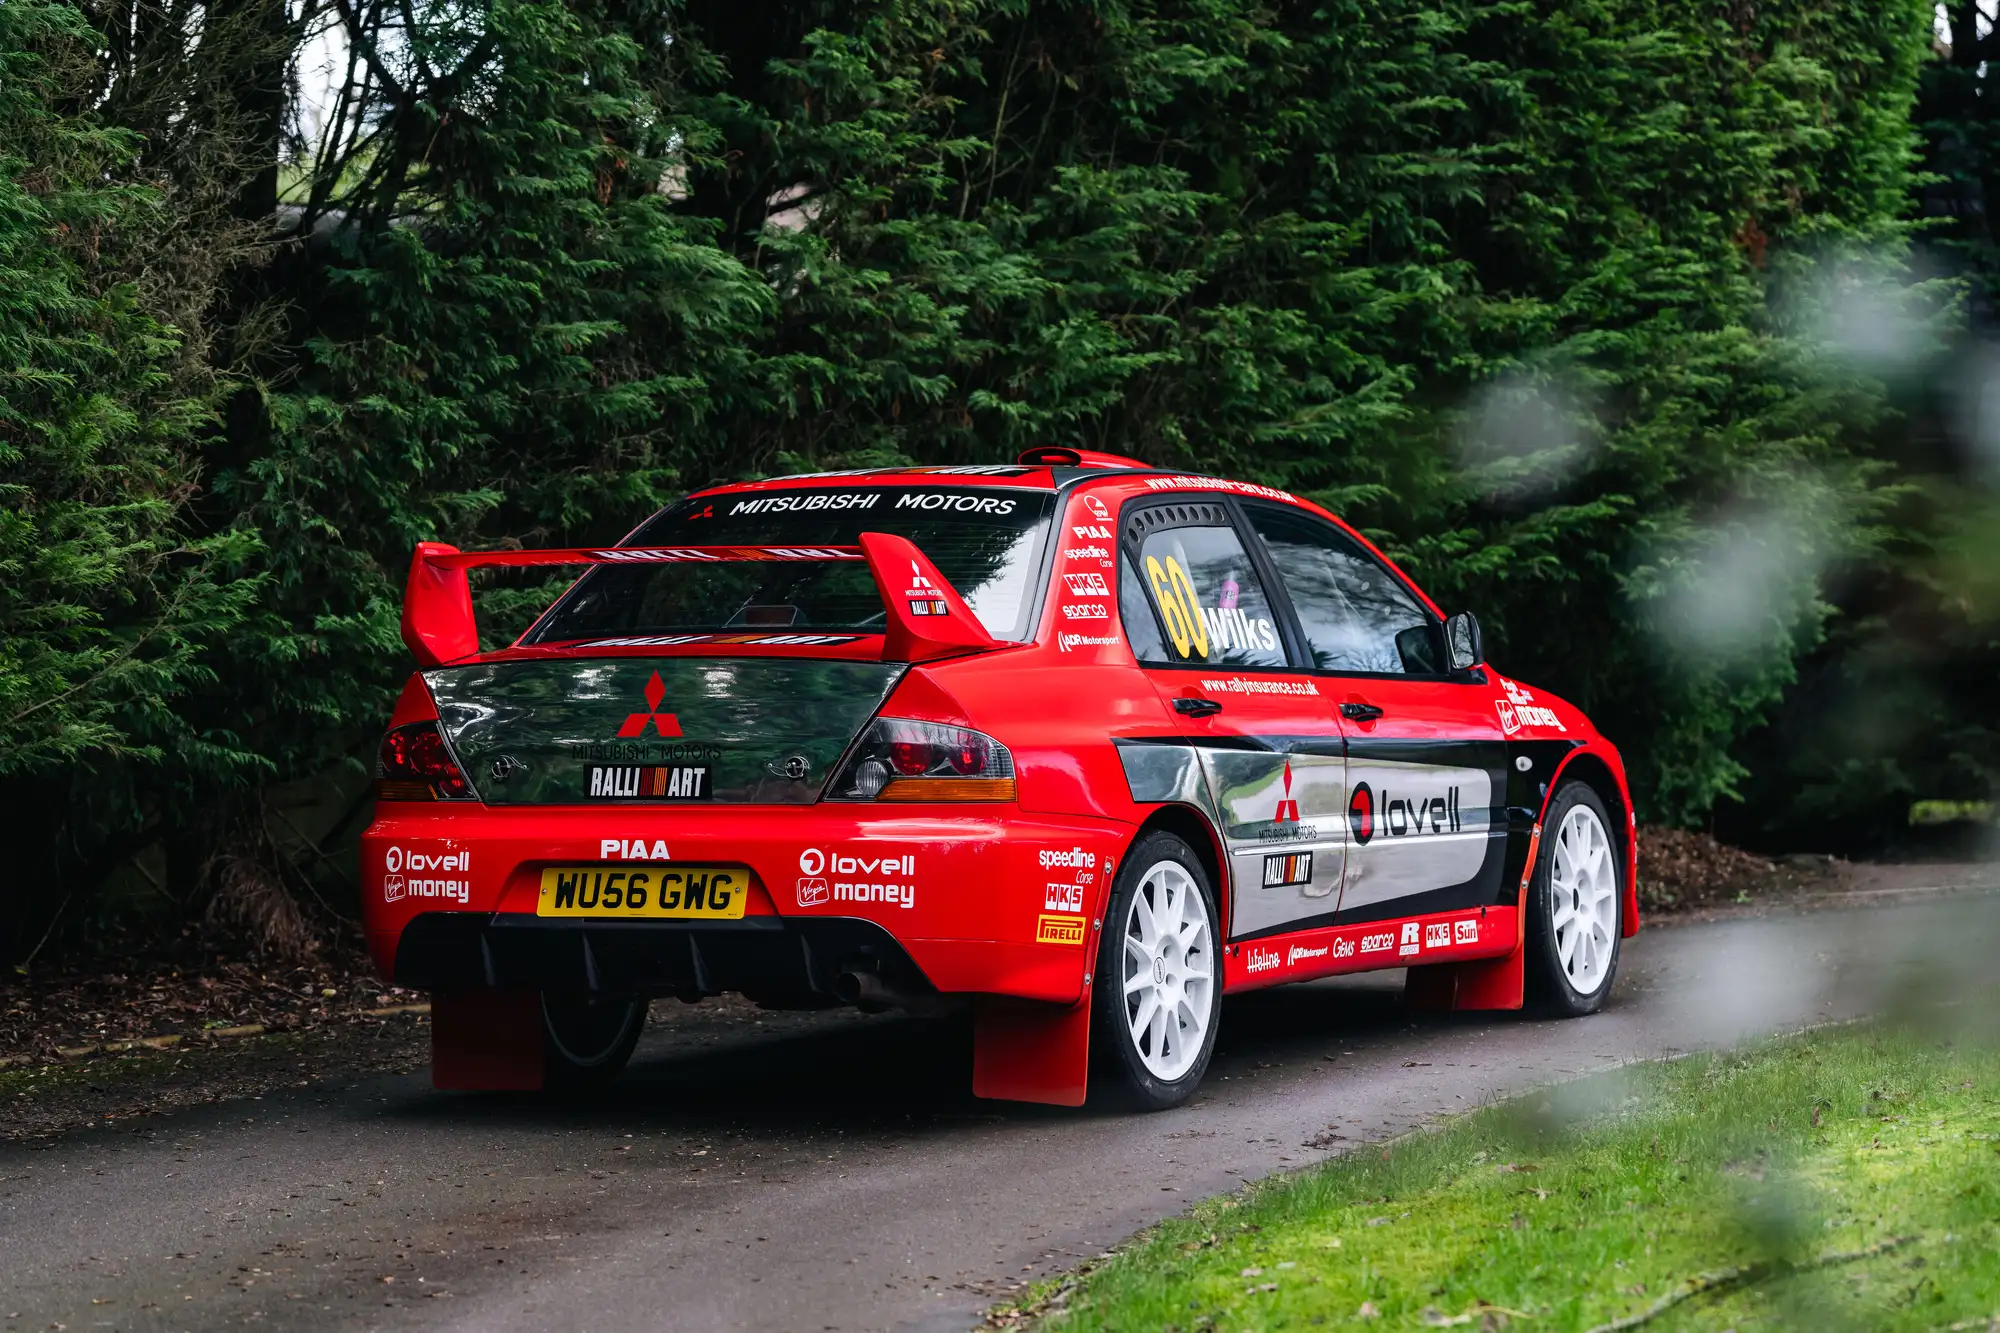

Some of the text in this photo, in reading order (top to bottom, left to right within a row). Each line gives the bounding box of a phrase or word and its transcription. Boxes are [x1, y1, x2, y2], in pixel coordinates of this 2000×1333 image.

[729, 494, 1016, 516] MITSUBISHI MOTORS
[1072, 526, 1112, 539] PIAA
[1064, 545, 1109, 560] speedline
[1064, 574, 1107, 592] HKS
[1063, 604, 1107, 619] sparco
[1146, 556, 1208, 659] 60
[1198, 608, 1275, 651] Wilks
[1082, 636, 1119, 646] Motorsport
[1201, 677, 1319, 695] www.rallyinsurance.co.uk
[1515, 706, 1567, 732] money
[572, 744, 721, 760] MITSUBISHI MOTORS
[1381, 786, 1460, 836] lovell
[1259, 825, 1317, 844] MITSUBISHI MOTORS
[601, 840, 670, 860] PIAA
[1039, 847, 1095, 870] speedline
[406, 850, 470, 871] lovell
[831, 853, 914, 875] lovell
[1076, 870, 1094, 884] Corse
[408, 879, 469, 903] money
[554, 872, 732, 910] WU56 GWG
[834, 882, 914, 908] money
[1046, 885, 1083, 906] HKS
[1038, 918, 1084, 940] PIRELLI
[1401, 922, 1419, 944] R
[1427, 925, 1449, 942] HKS
[1457, 925, 1476, 940] Sun
[1304, 947, 1328, 958] Motorsport
[1361, 933, 1394, 952] sparco
